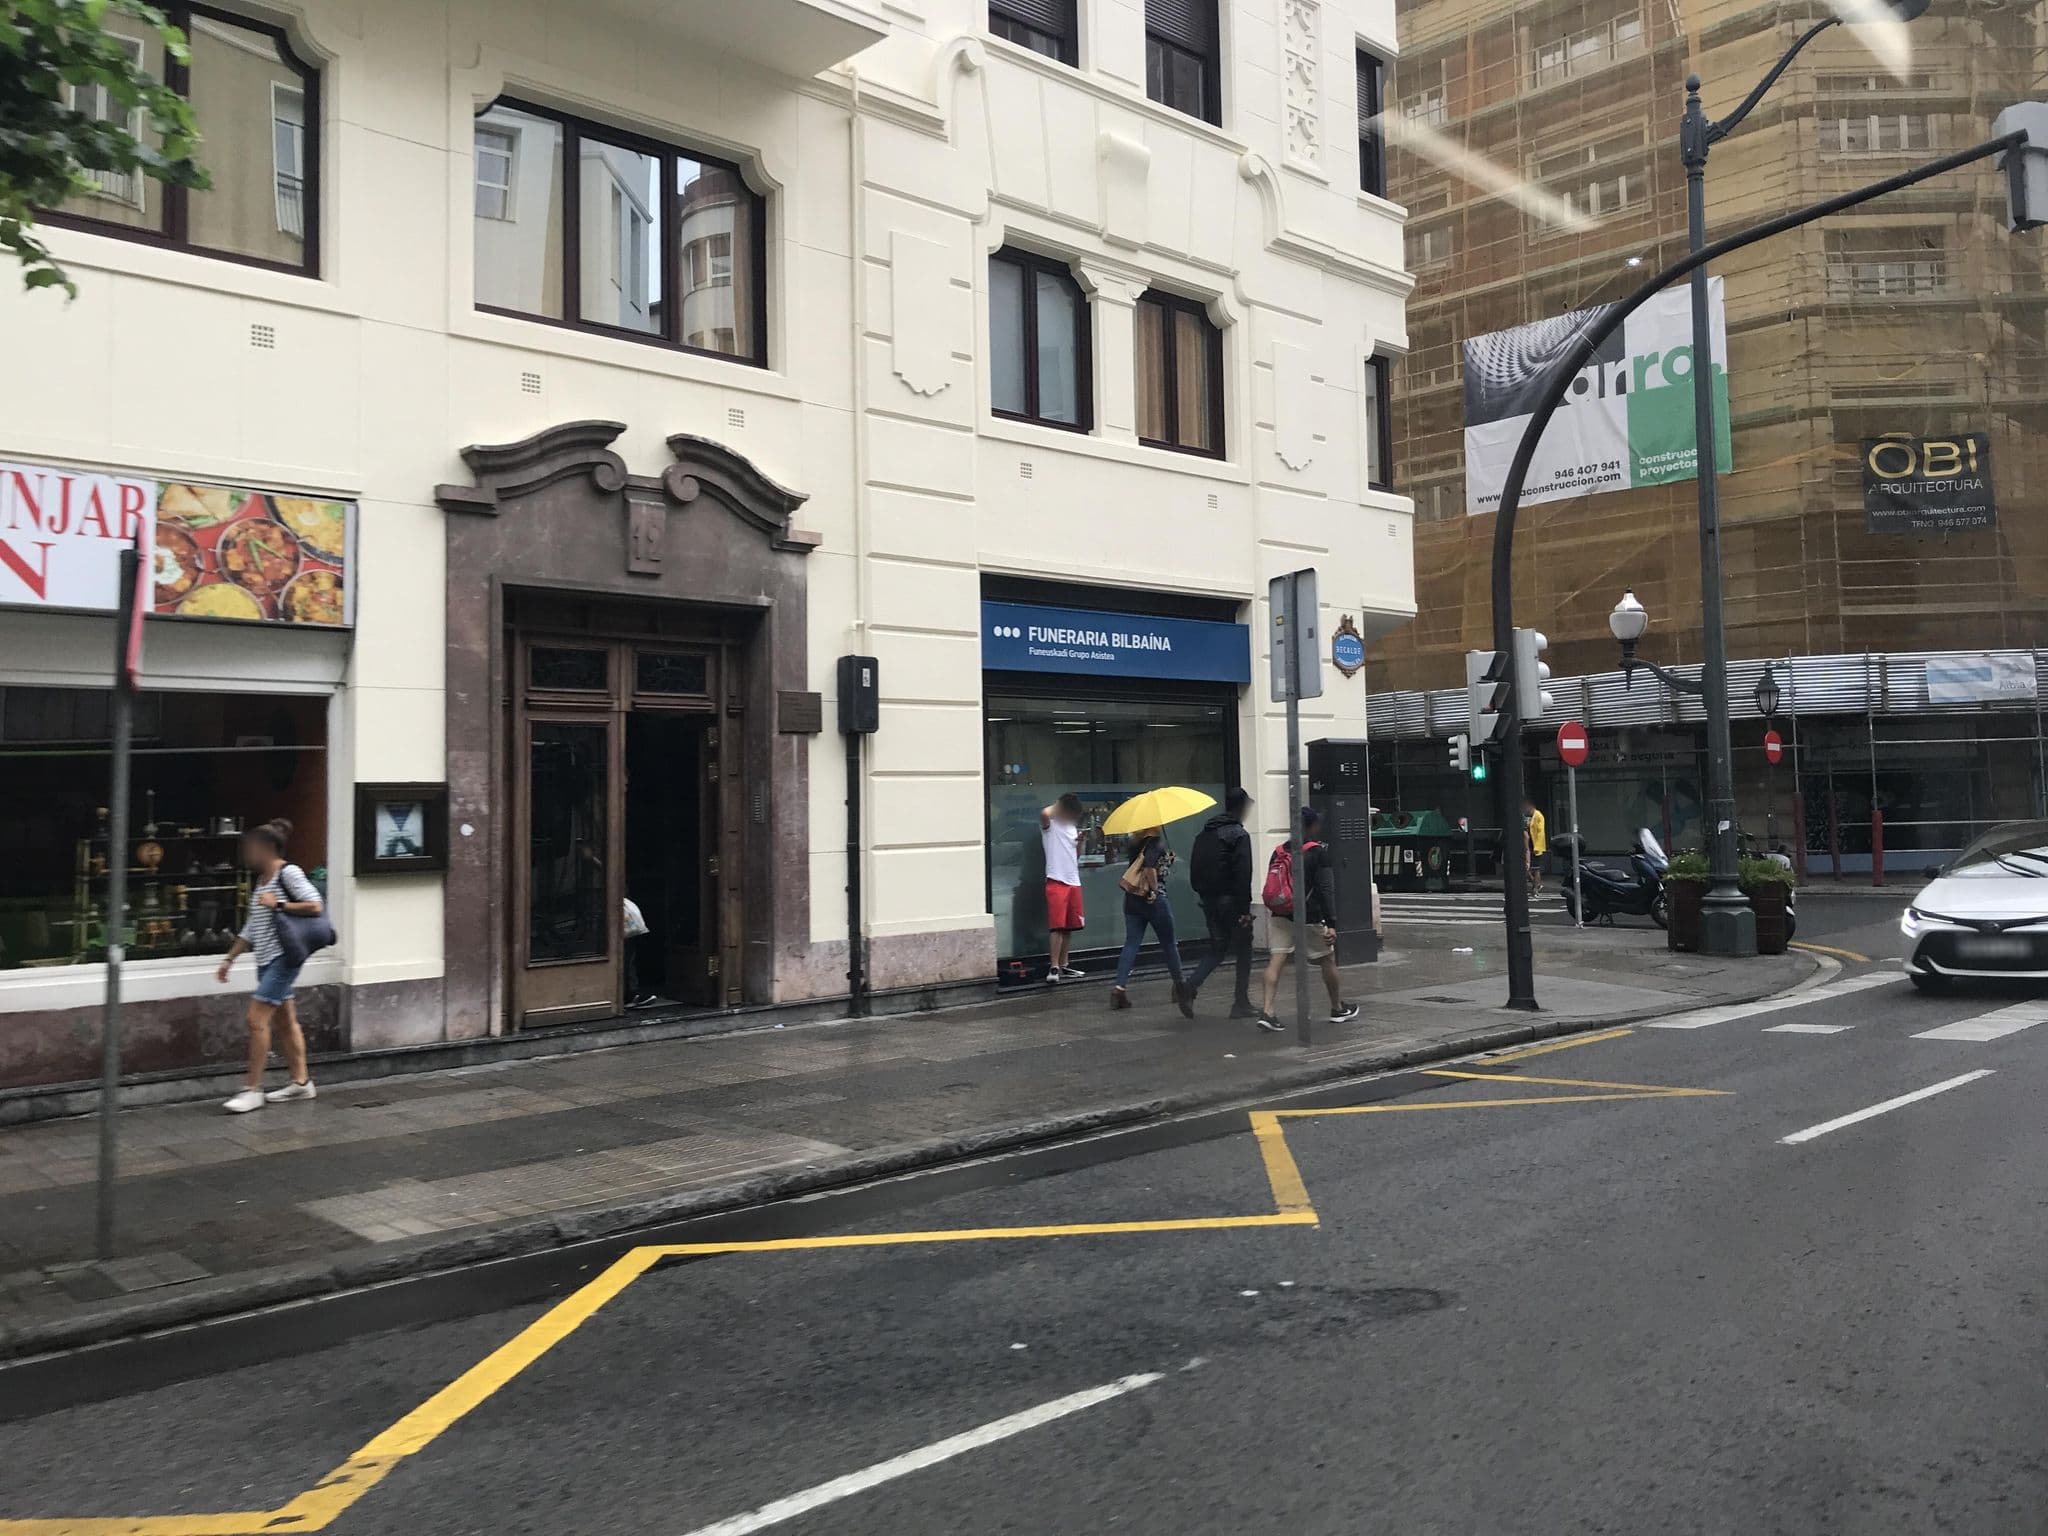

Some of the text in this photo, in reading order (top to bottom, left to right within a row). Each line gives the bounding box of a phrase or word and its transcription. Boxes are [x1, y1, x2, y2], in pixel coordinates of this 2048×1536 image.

[1639, 448, 1698, 465] construcc
[1554, 460, 1621, 480] 946 407 941
[1640, 459, 1698, 478] proyectos
[1868, 478, 1984, 496] ARQUITECTURA
[1028, 626, 1172, 651] FUNERARIA BILBAÍNA
[1029, 646, 1115, 660] Funeuskadi Grupo Asistea
